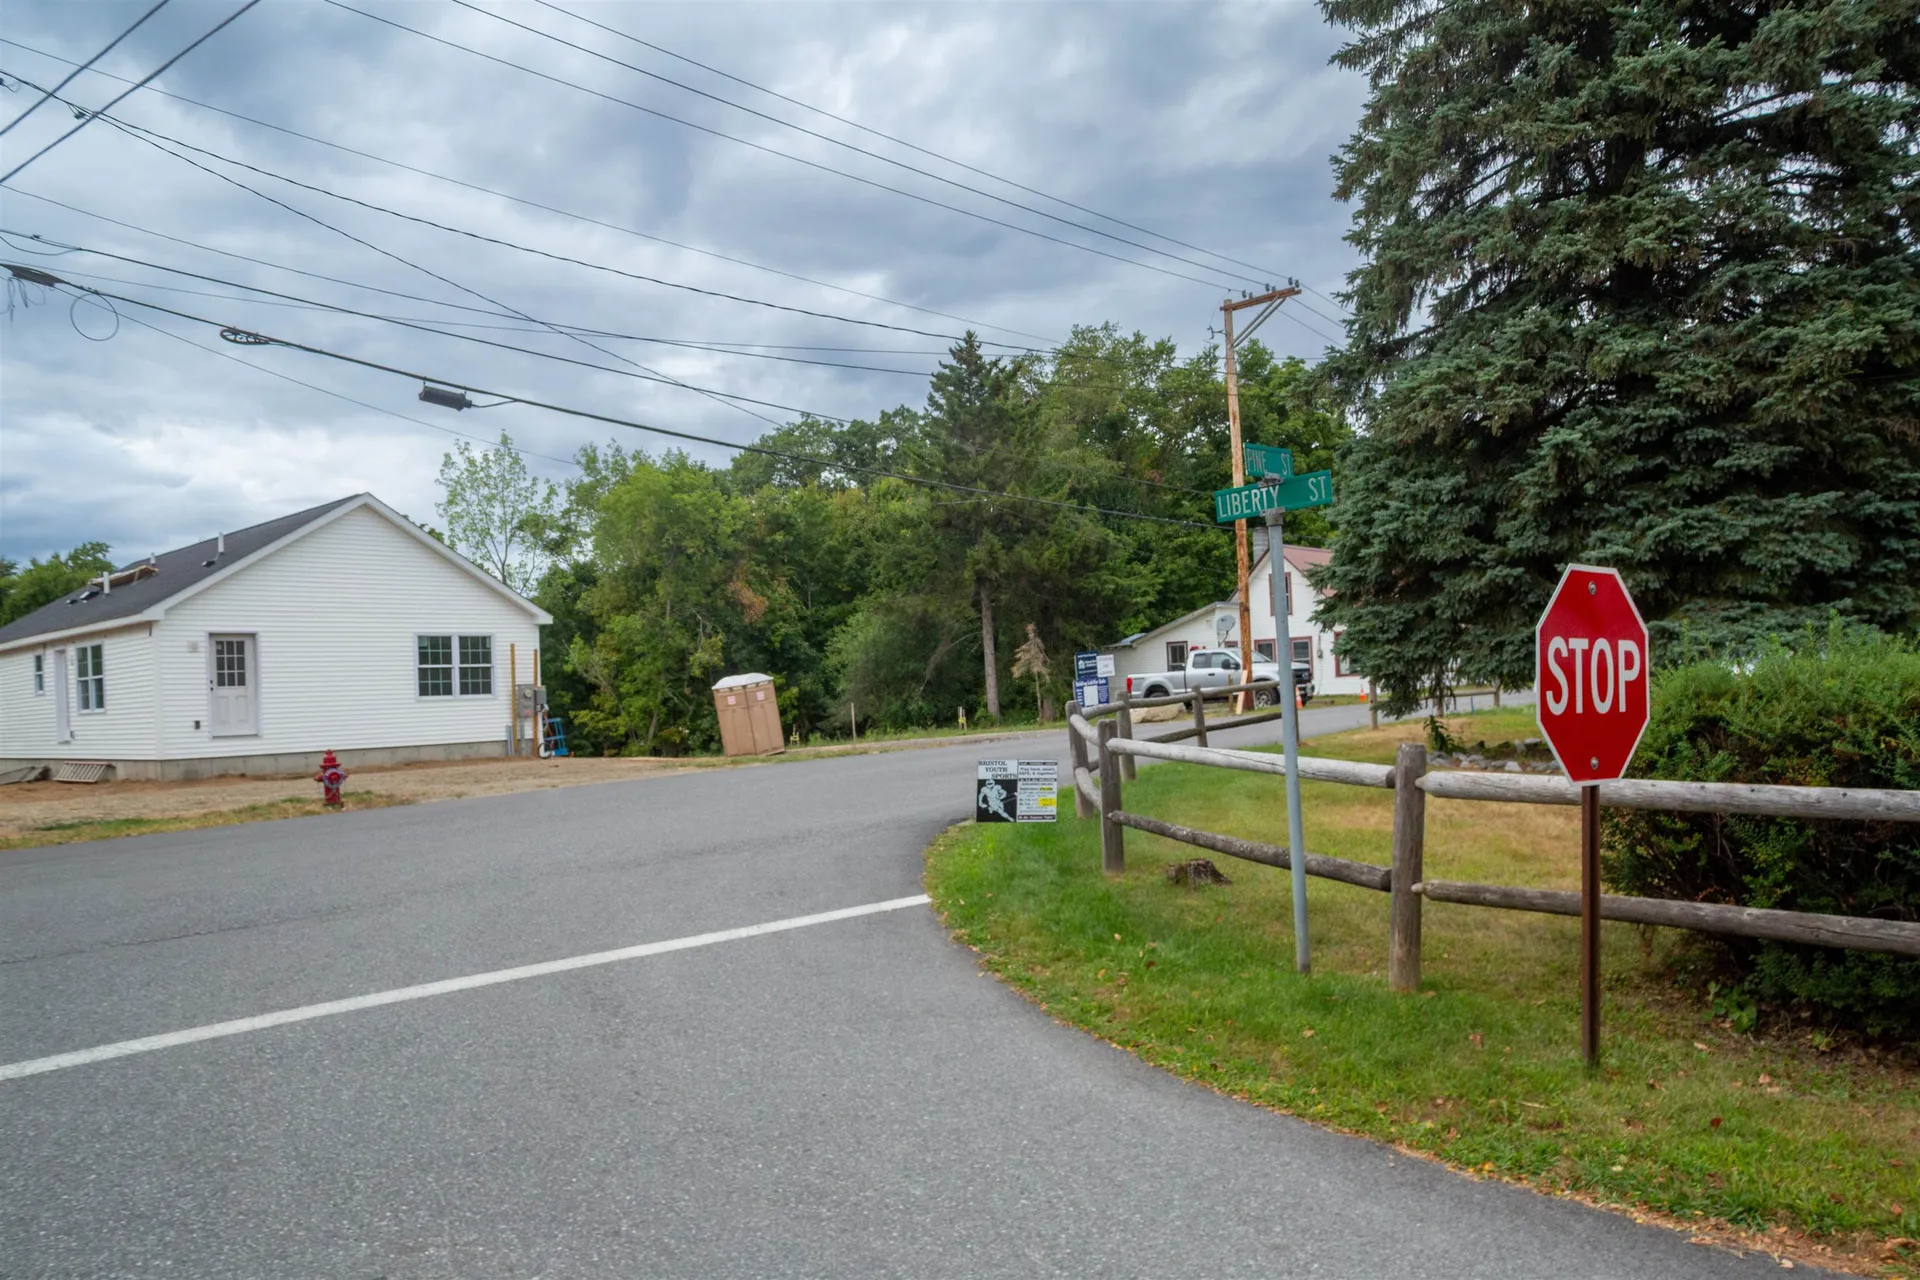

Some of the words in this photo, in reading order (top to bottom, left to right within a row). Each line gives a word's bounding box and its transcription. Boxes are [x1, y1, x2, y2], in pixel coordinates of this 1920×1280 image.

[1246, 448, 1266, 472] PINE
[1280, 452, 1292, 476] ST
[1218, 485, 1279, 518] LIBERTY
[1308, 475, 1326, 502] ST
[1546, 635, 1641, 716] STOP
